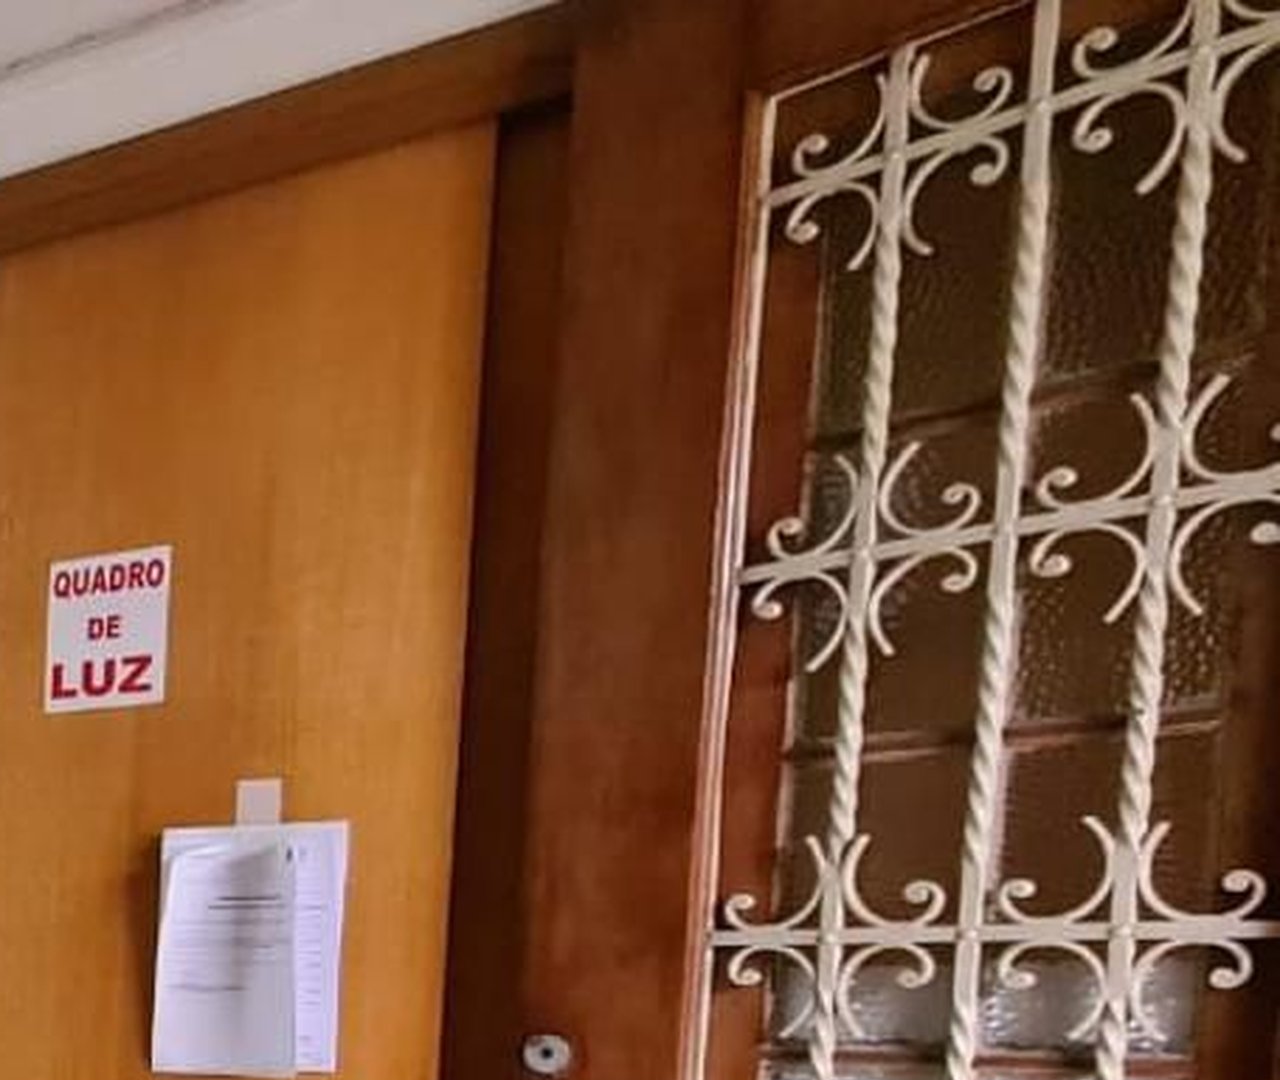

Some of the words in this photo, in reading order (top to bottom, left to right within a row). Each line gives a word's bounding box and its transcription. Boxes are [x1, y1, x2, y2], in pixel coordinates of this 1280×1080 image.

[53, 558, 165, 598] QUADRO
[87, 614, 122, 641] DE
[50, 654, 153, 700] LUZ
